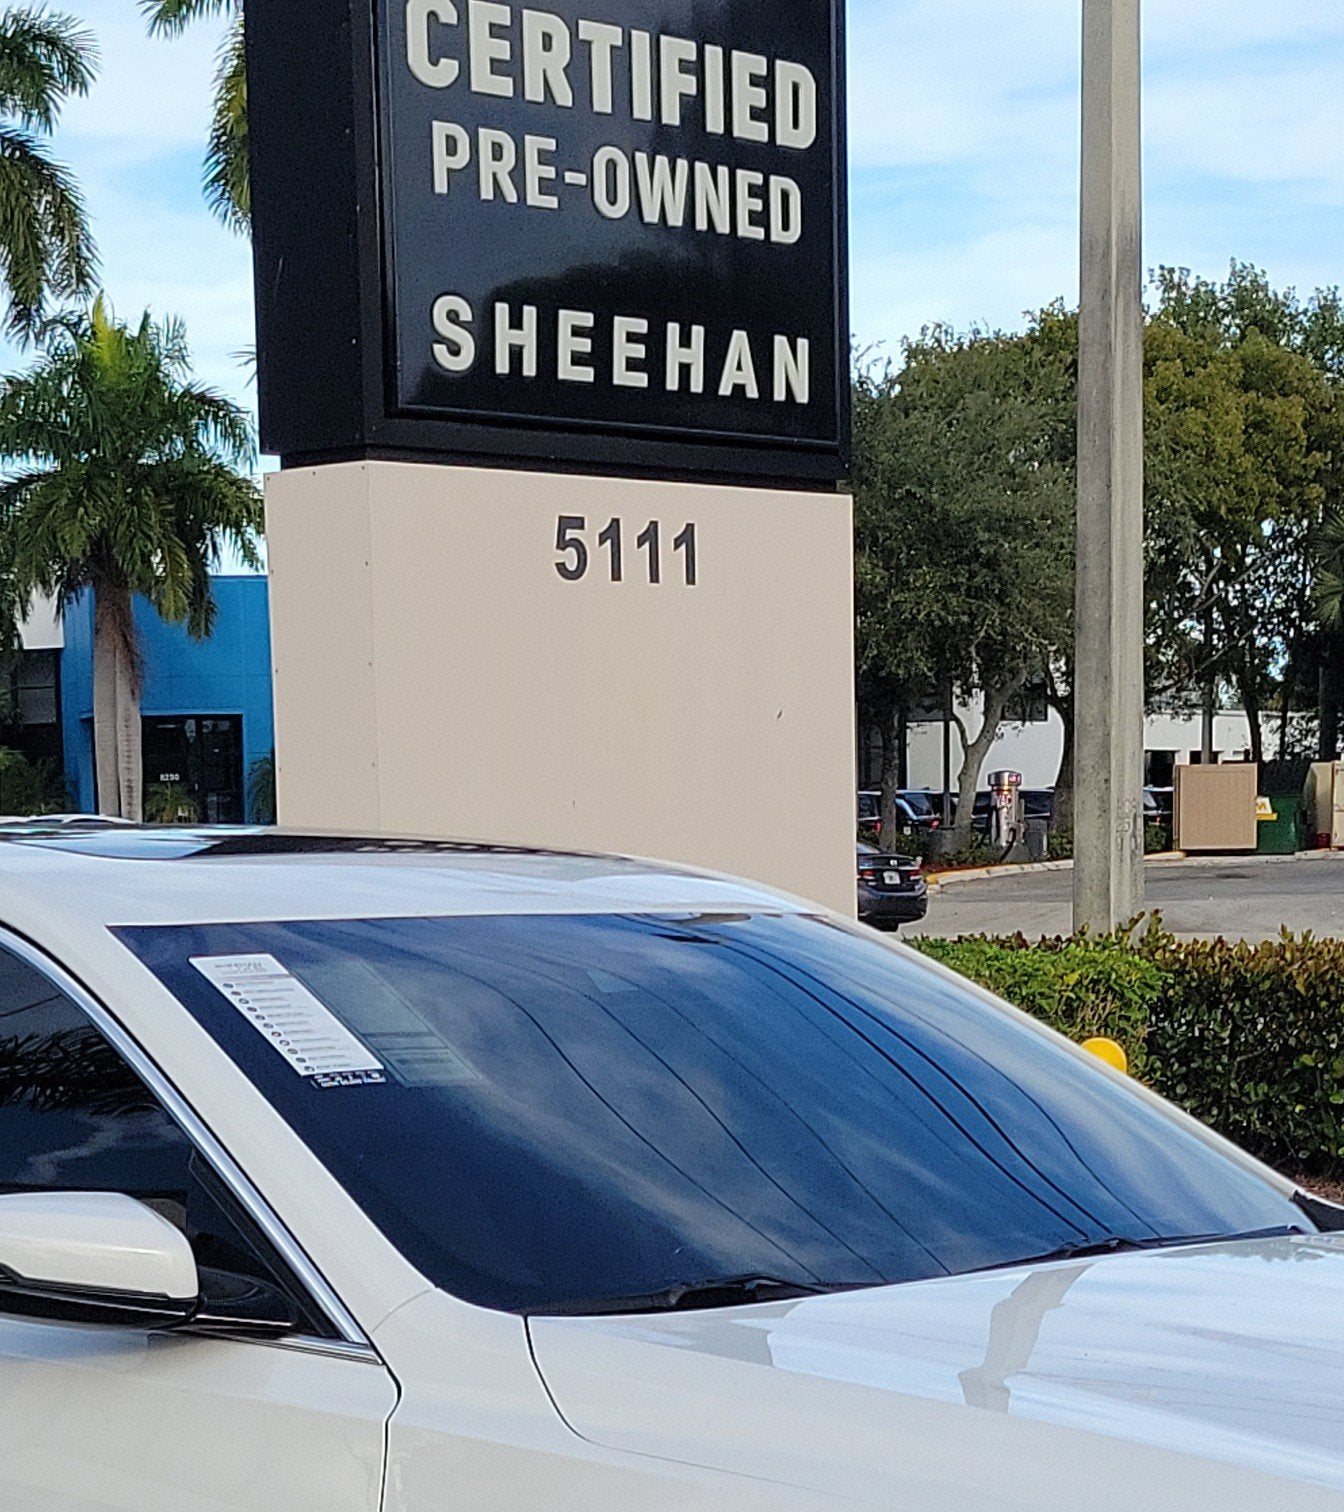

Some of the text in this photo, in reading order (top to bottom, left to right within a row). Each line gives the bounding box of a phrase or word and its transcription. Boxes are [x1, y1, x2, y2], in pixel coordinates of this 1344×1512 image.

[406, 0, 817, 149] CERTIFIED
[432, 121, 801, 244] PRE-OWNED
[432, 295, 809, 404] SHEEHAN
[555, 514, 696, 586] 5111
